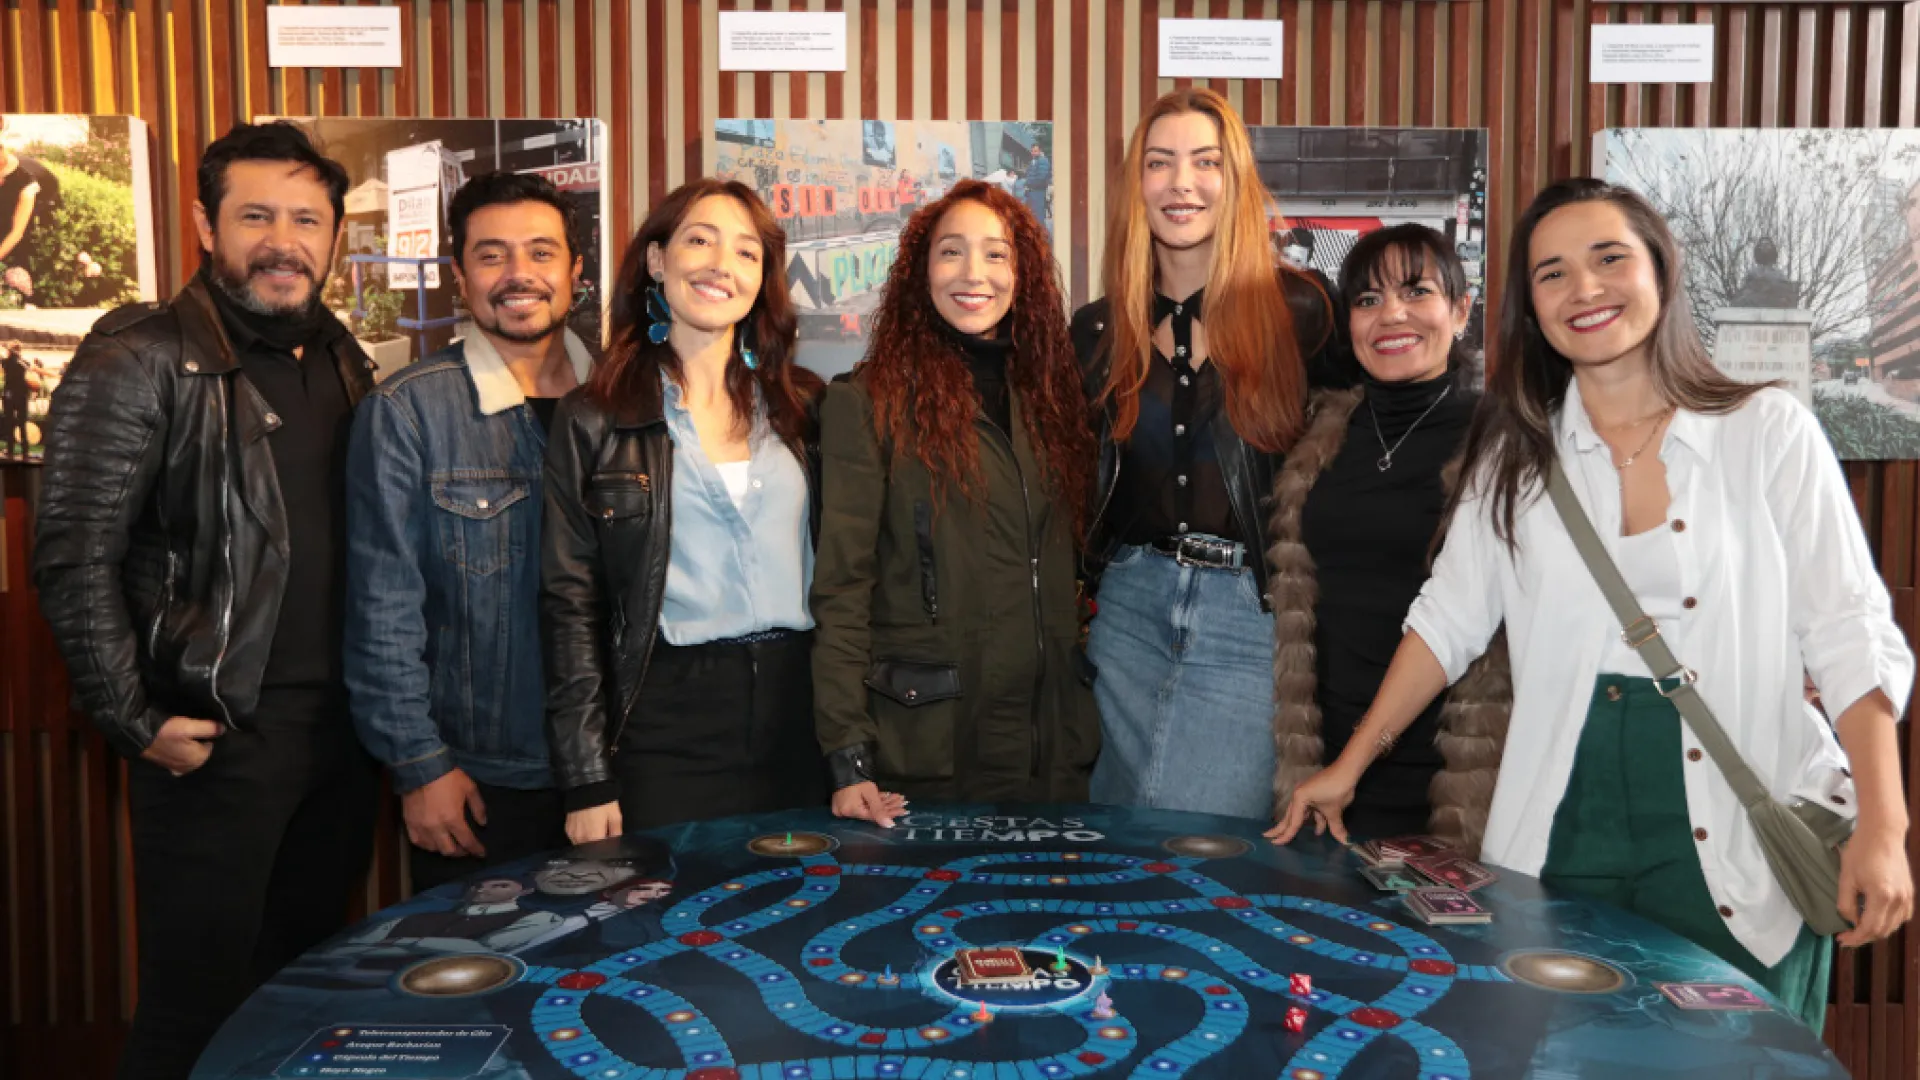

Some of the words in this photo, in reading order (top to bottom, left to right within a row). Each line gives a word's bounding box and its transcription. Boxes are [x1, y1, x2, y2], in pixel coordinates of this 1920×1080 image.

[779, 187, 834, 214] SIN
[398, 231, 430, 257] 92
[901, 815, 1085, 828] GESTAS
[895, 828, 1106, 842] TIEMPO
